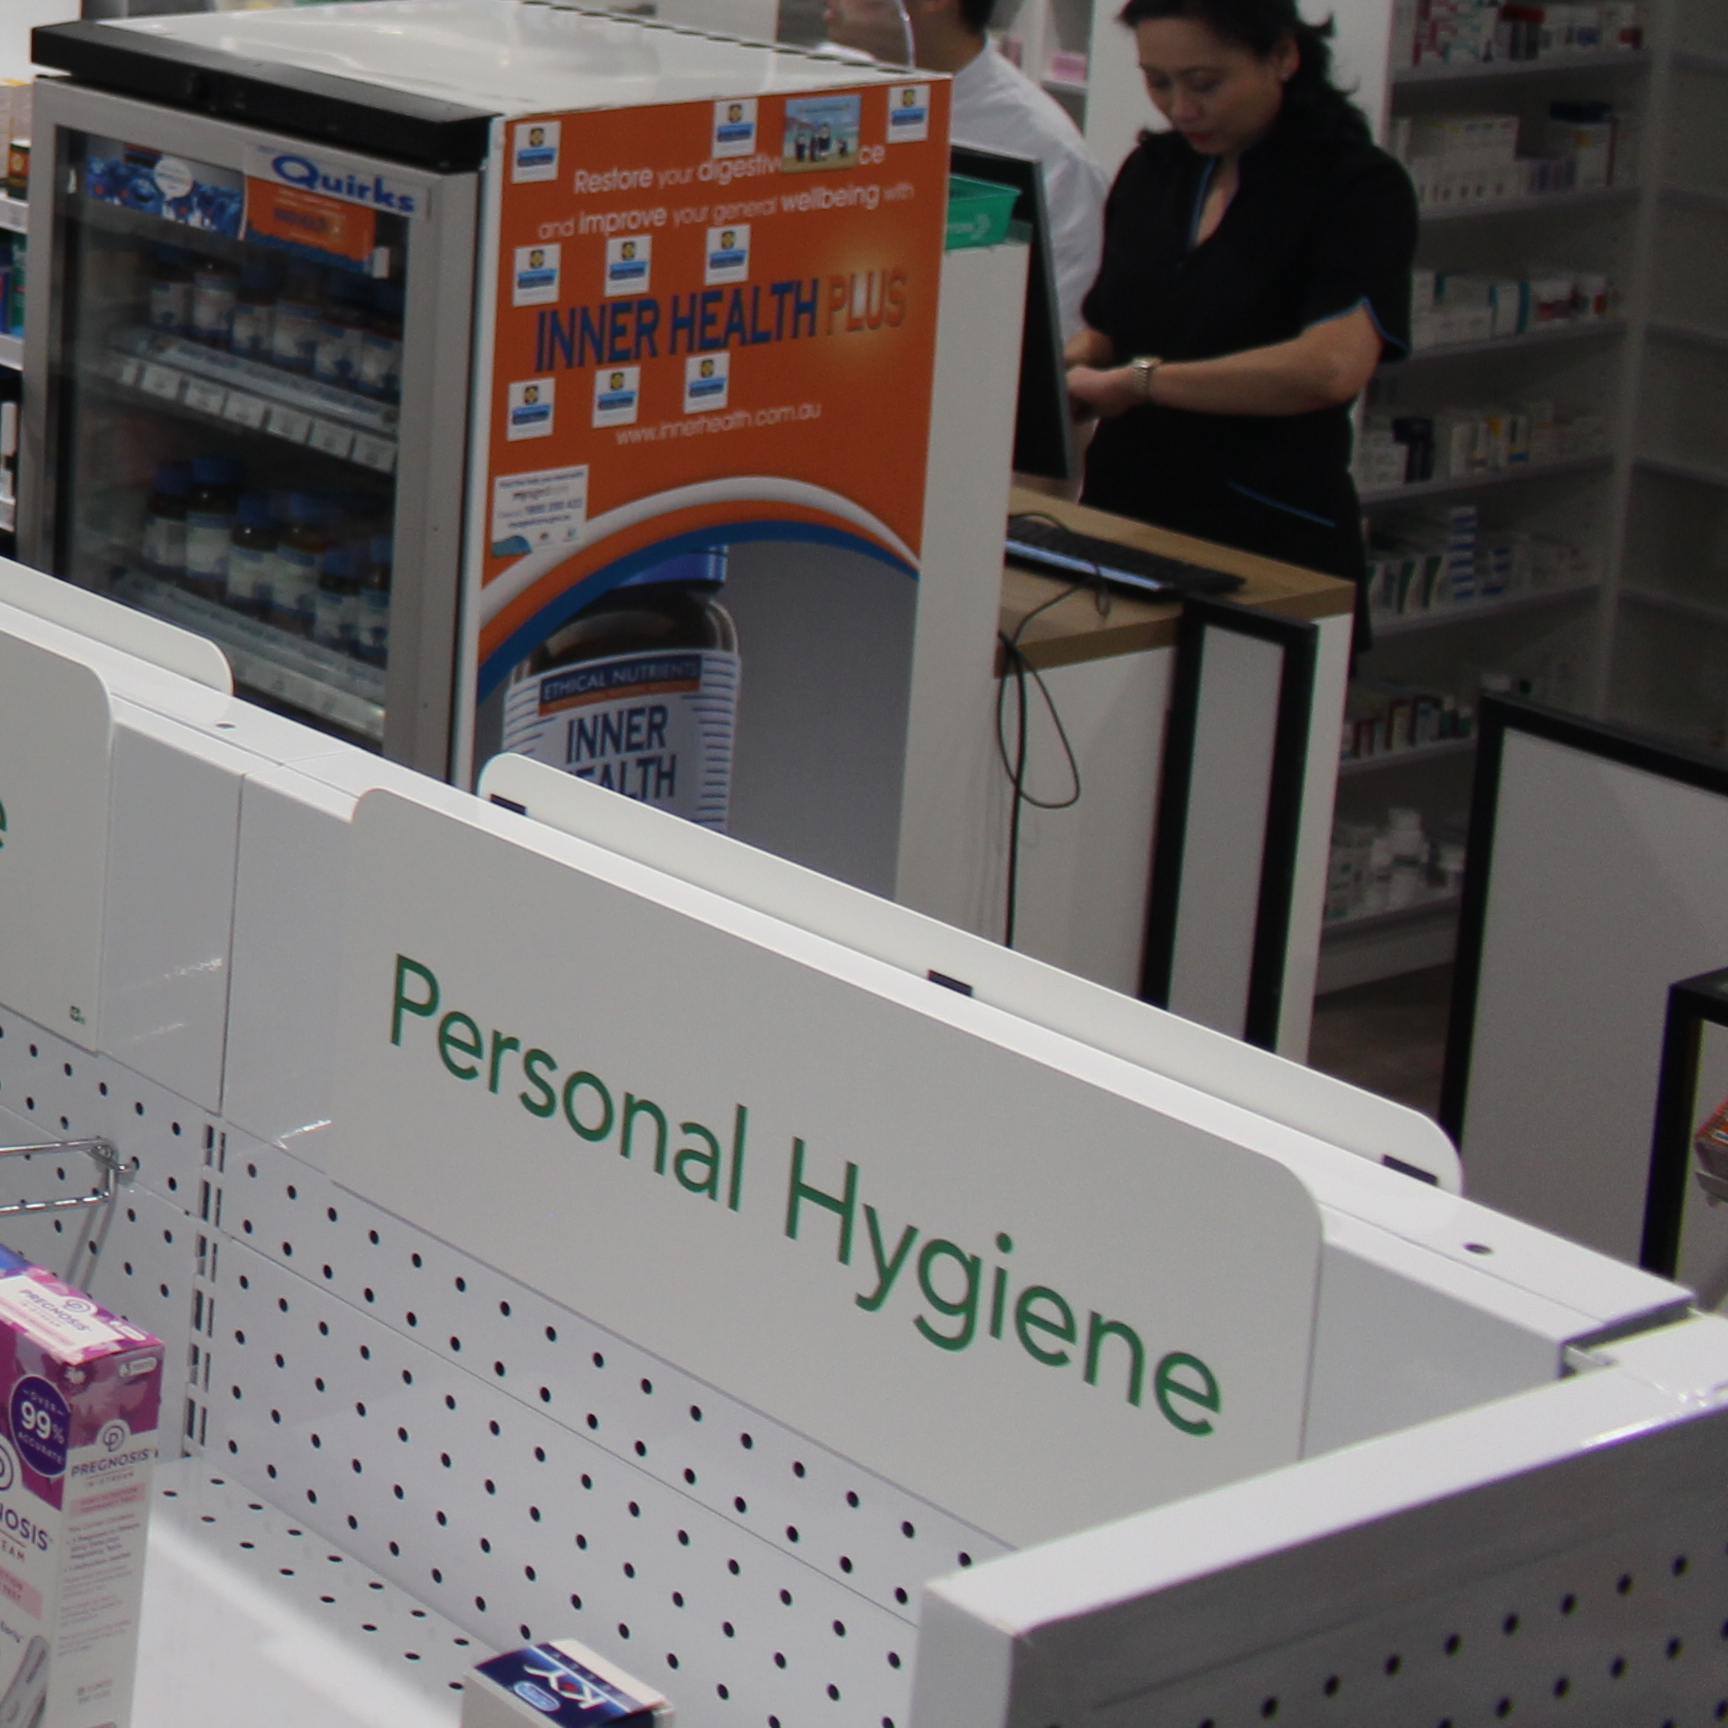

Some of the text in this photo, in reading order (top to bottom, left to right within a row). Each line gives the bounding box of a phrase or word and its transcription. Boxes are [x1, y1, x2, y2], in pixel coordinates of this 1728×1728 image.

[272, 155, 415, 213] Quirks
[574, 164, 654, 195] Restore
[657, 167, 694, 192] your
[538, 181, 915, 240] and improve your general wellbeing with
[535, 271, 908, 371] INNER HEALTH PLUS
[616, 402, 821, 446] www.innerhealth.com.au
[544, 657, 701, 702] ETHICAL NUTRIENTS
[566, 704, 668, 764] INNER
[390, 953, 1221, 1436] Personal Hygiene
[19, 1289, 89, 1332] PREGNOSIS
[20, 1400, 66, 1446] 99%
[71, 1449, 150, 1478] PREGNOSIS
